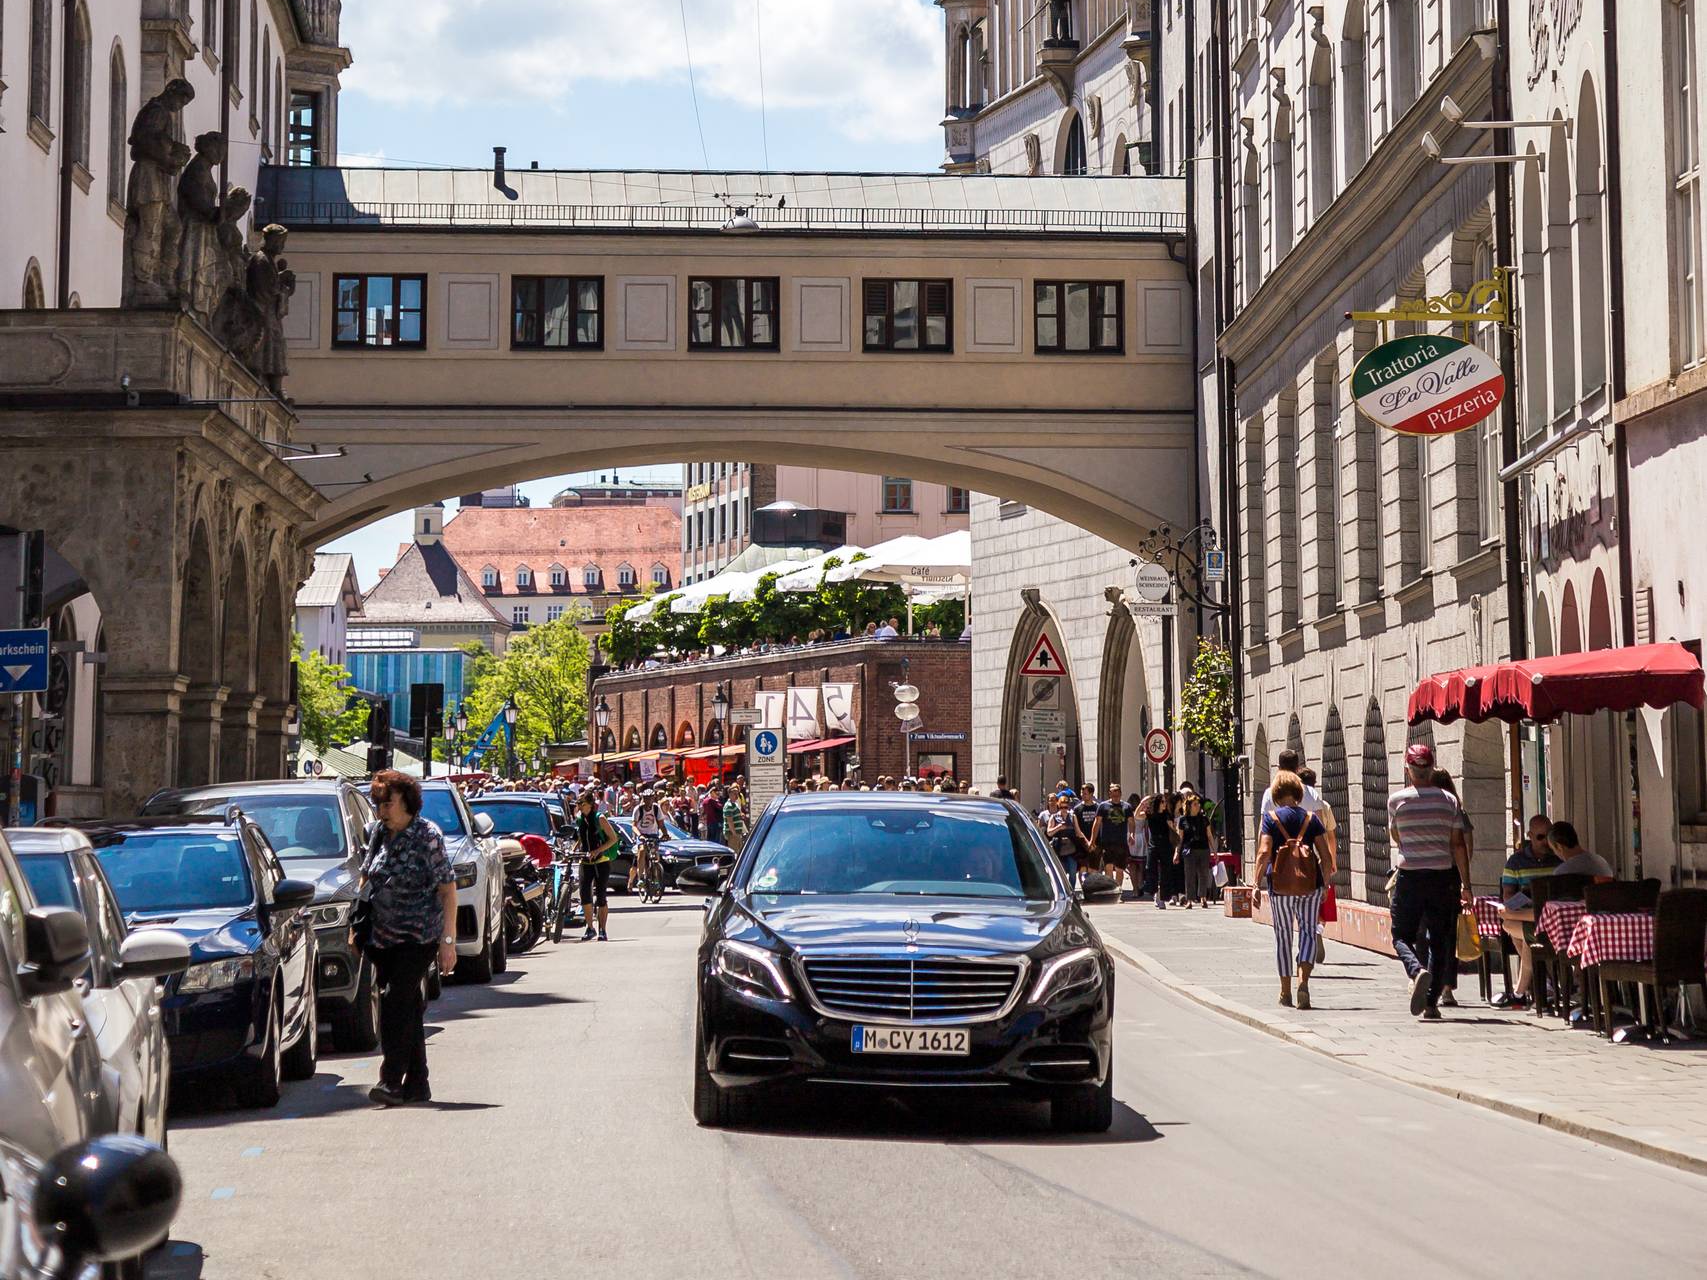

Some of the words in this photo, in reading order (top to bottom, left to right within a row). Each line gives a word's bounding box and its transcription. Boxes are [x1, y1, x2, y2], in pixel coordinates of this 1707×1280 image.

[1364, 344, 1439, 386] Trattoria
[1379, 386, 1421, 415] La
[1417, 357, 1480, 394] Valle
[1427, 390, 1497, 429] Pizzeria
[911, 566, 930, 576] Café
[864, 1030, 877, 1049] M
[889, 1031, 914, 1050] CY
[918, 1032, 966, 1051] 1612
